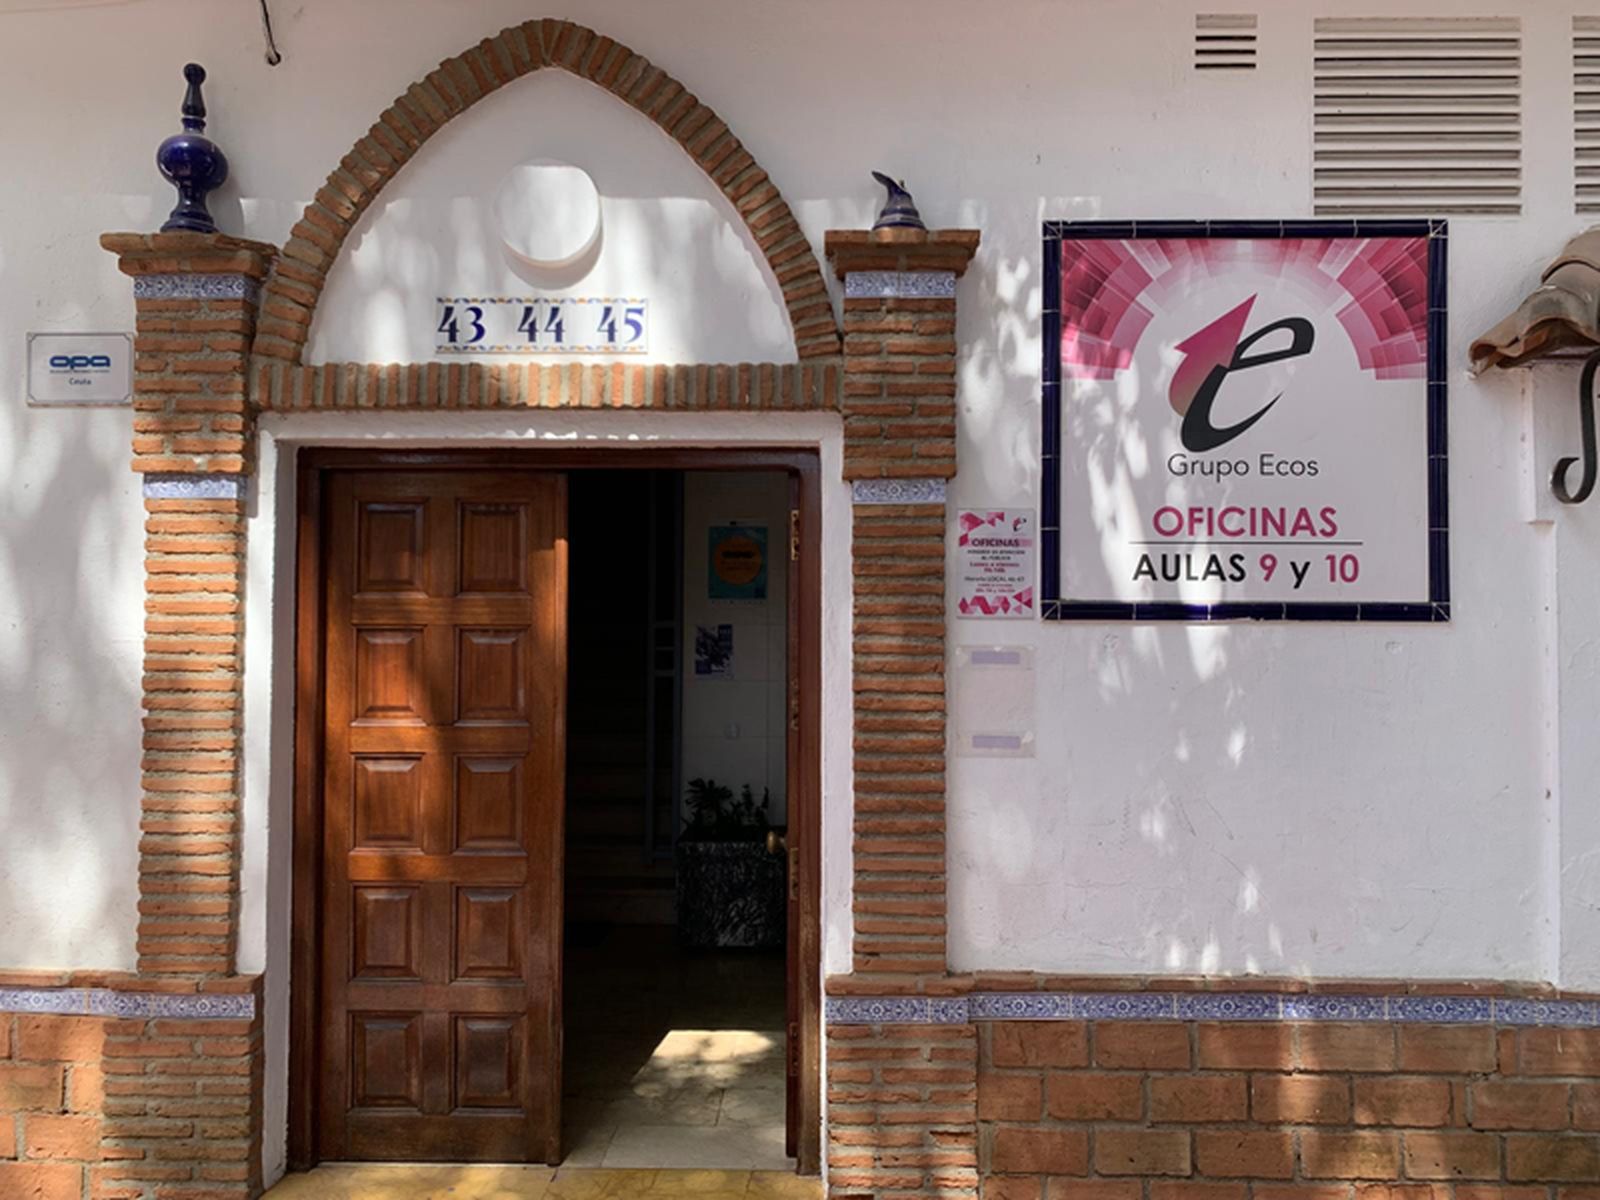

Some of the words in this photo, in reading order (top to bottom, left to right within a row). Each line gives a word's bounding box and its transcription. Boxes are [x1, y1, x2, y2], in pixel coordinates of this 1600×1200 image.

[436, 305, 487, 344] 43
[517, 305, 566, 344] 44
[596, 305, 645, 344] 45
[1167, 453, 1250, 483] Grupo
[1259, 453, 1319, 476] Ecos
[1152, 506, 1339, 537] OFICINAS
[971, 538, 1020, 548] OFICINAS
[1132, 553, 1247, 583] AULAS
[1259, 553, 1278, 583] 9
[1289, 560, 1311, 590] y
[1325, 553, 1360, 583] 10
